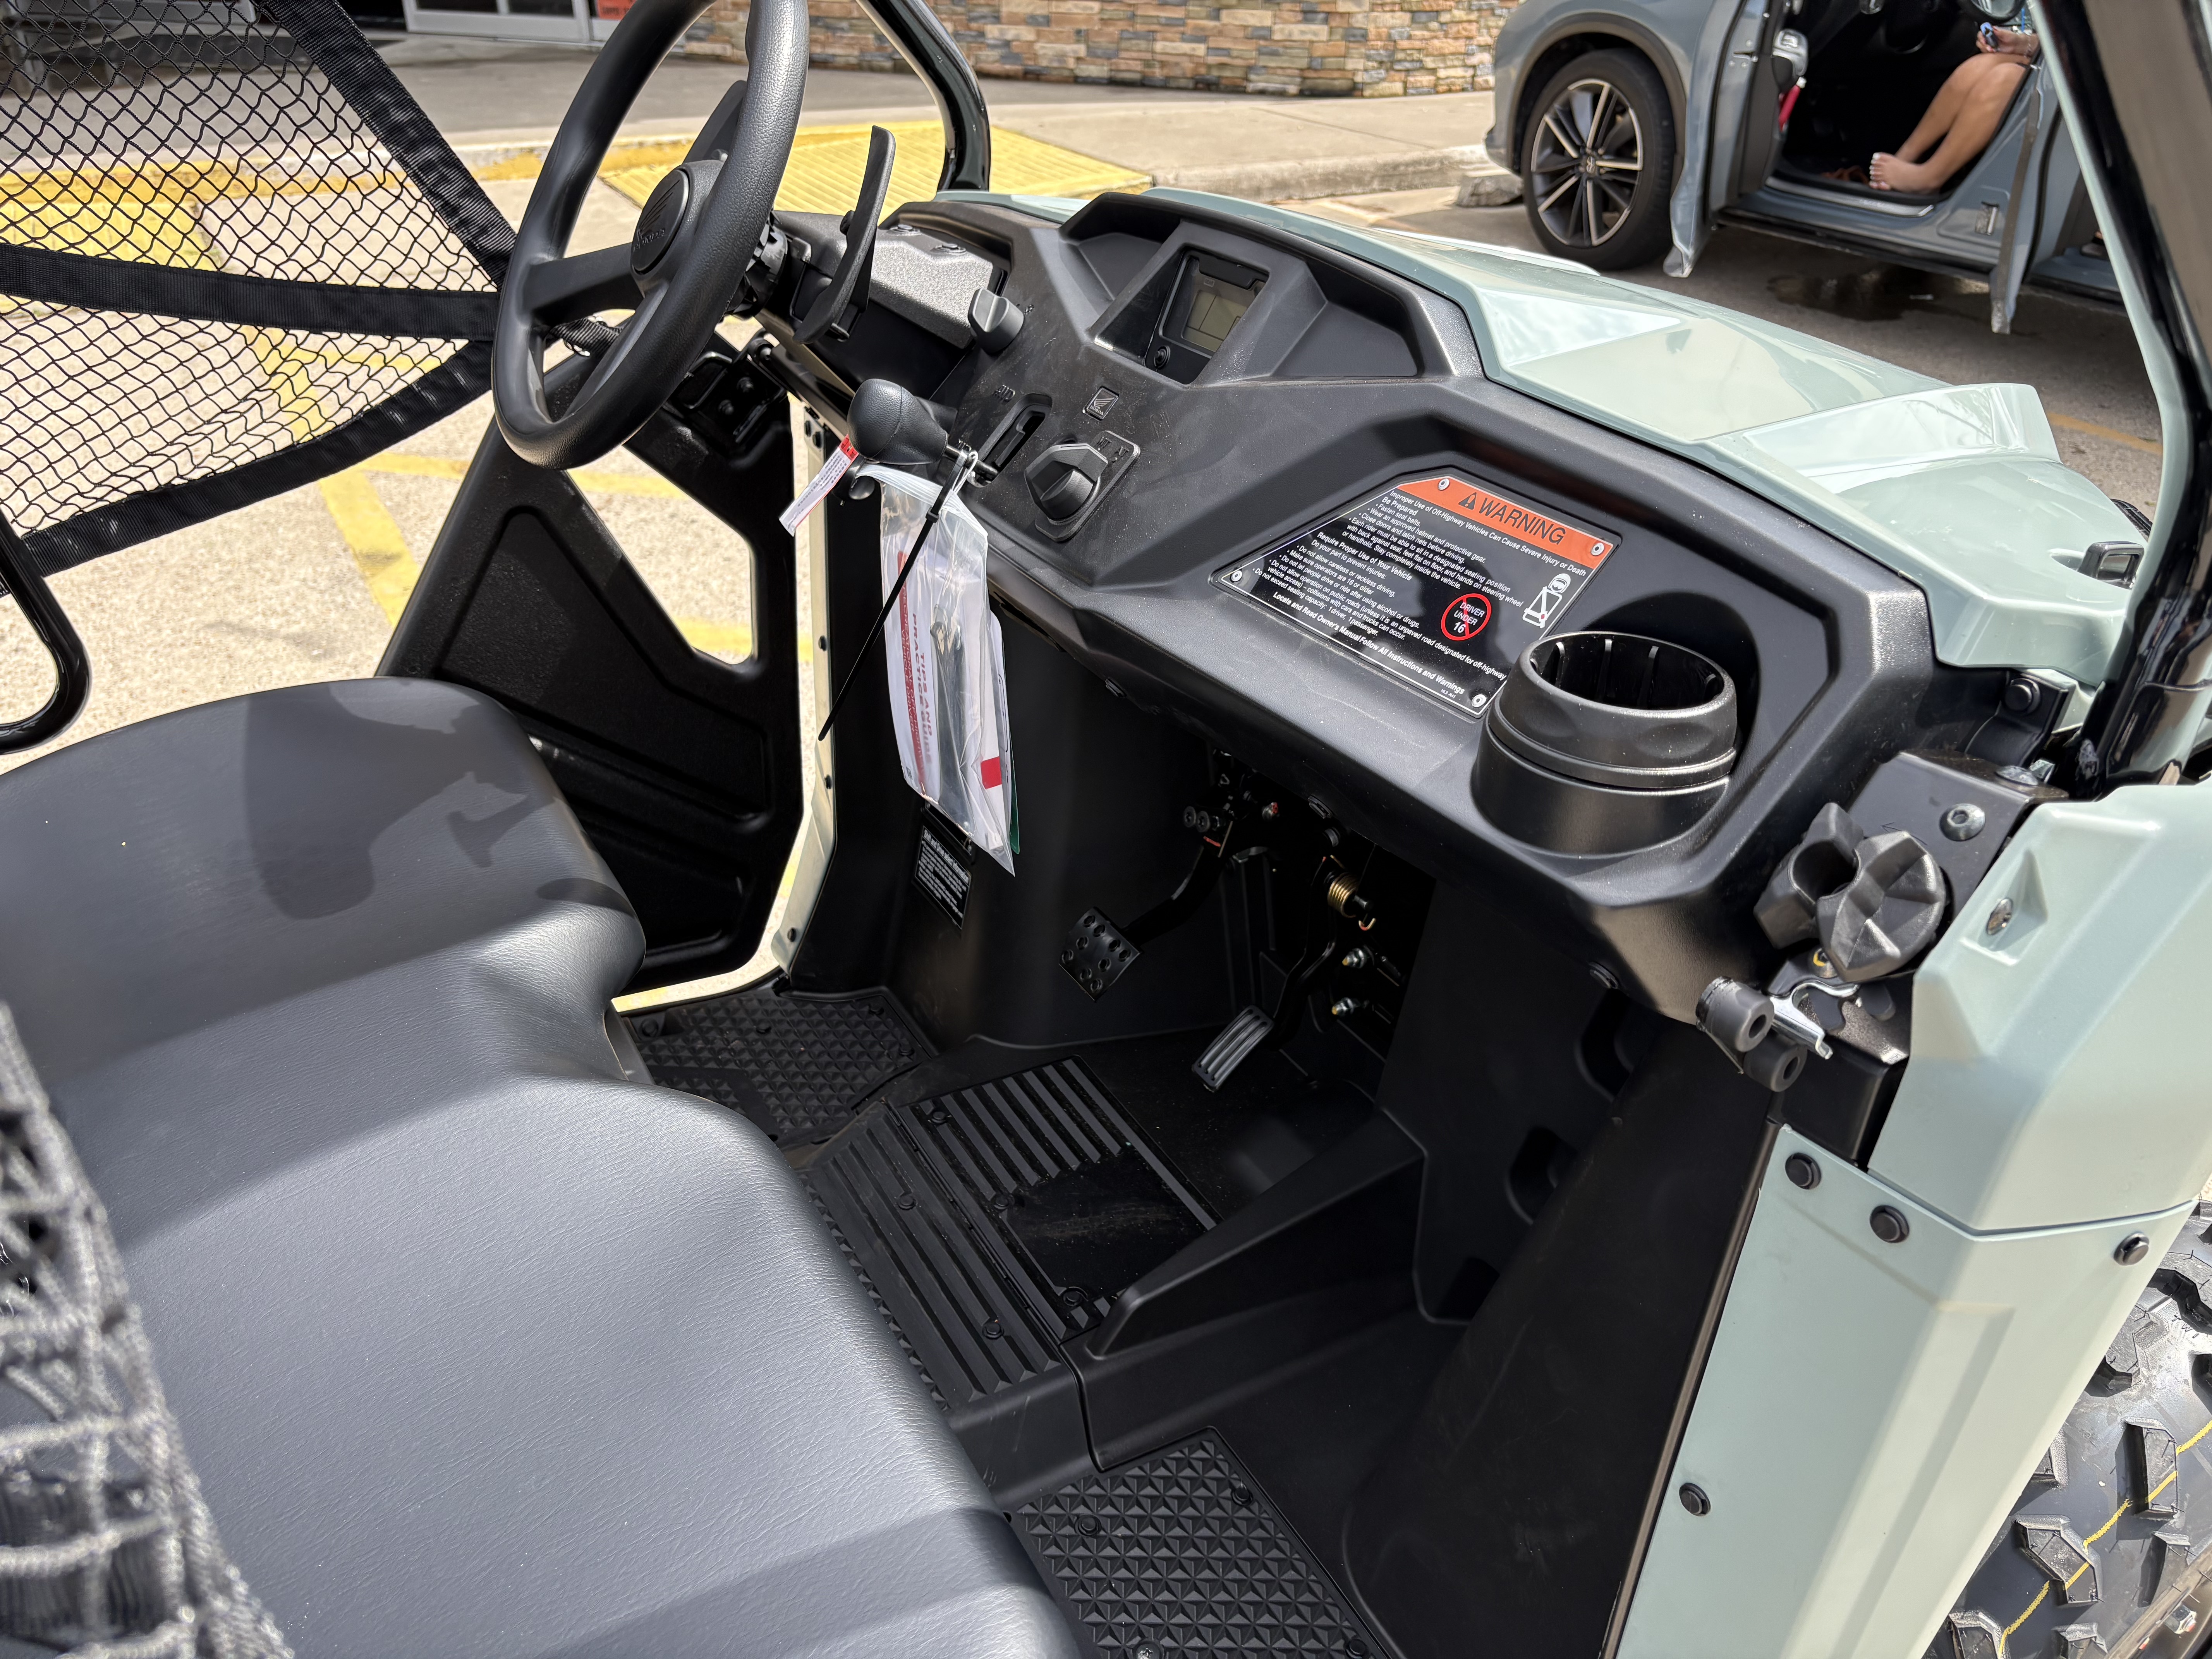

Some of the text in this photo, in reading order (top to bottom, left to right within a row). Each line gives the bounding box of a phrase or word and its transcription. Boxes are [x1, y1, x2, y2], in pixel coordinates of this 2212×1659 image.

[1377, 503, 1420, 527] Fasten seat belts.
[1382, 496, 1419, 516] Be Prepared
[1479, 498, 1566, 544] WARNING
[1317, 531, 1339, 546] Require
[1338, 542, 1359, 555] Proper
[1358, 551, 1370, 561] Use
[1377, 560, 1391, 570] Your
[1391, 566, 1412, 581] Vehicle
[1351, 517, 1365, 527] Each
[1364, 524, 1377, 532] rider
[1376, 530, 1391, 539] must
[1397, 539, 1410, 548] able
[1433, 555, 1466, 572] designated
[1464, 569, 1486, 583] seating
[1485, 579, 1511, 593] position
[1361, 513, 1465, 564] Close doors and latch nets before driving.
[1370, 508, 1384, 518] Wear
[1390, 518, 1417, 532] approved
[1415, 528, 1435, 540] helmet
[1443, 542, 1472, 557] protective
[1470, 554, 1486, 563] gear.
[1389, 490, 1415, 505] Improper
[1414, 500, 1425, 509] Use
[1432, 508, 1465, 527] Off-Highway
[1465, 522, 1489, 536] Vehicles
[1489, 532, 1501, 541] Can
[1501, 537, 1520, 550] Cause
[1520, 545, 1542, 558] Severe
[1541, 554, 1560, 567] Injury
[1567, 564, 1586, 576] Death
[1289, 550, 1303, 560] Make
[1302, 557, 1314, 566] sure
[1314, 563, 1338, 577] operators
[1359, 586, 1374, 595] older
[1311, 539, 1320, 547] Do
[1318, 544, 1332, 553] your
[1329, 550, 1343, 558] part
[1345, 557, 1367, 570] prevent
[1365, 565, 1387, 580] injuries:
[1315, 555, 1329, 563] allow
[1328, 561, 1349, 574] careless
[1355, 574, 1377, 587] reckless
[1376, 584, 1395, 598] driving.
[1347, 524, 1358, 533] with
[1357, 529, 1371, 539] back
[1370, 536, 1391, 548] against
[1389, 544, 1402, 554] seat,
[1402, 549, 1415, 559] feet
[1413, 554, 1424, 563] flat
[1430, 562, 1444, 574] floor,
[1444, 569, 1457, 578] and
[1455, 573, 1474, 586] hands
[1481, 586, 1505, 601] steering
[1505, 596, 1524, 607] wheel
[1348, 532, 1373, 549] handhold.
[1374, 544, 1387, 555] Stay
[1386, 551, 1415, 568] completely
[1414, 563, 1431, 575] inside
[1431, 571, 1441, 580] the
[1440, 576, 1461, 589] vehicle.
[1303, 568, 1321, 579] people
[1321, 576, 1334, 585] drive
[1339, 585, 1350, 593] ride
[1350, 591, 1363, 599] after
[1362, 596, 1377, 608] using
[1376, 604, 1398, 617] alcohol
[1403, 617, 1419, 629] drugs.
[1454, 610, 1478, 626] UNDER
[1460, 601, 1485, 618] DRIVER
[1273, 591, 1465, 694] Locate and Read Owner's Manual Follow All Instructions and Warnings
[1286, 568, 1301, 578] allow
[1300, 575, 1323, 590] operation
[1329, 591, 1346, 601] public
[1345, 598, 1361, 609] roads
[1360, 605, 1380, 618] (unless
[1398, 625, 1423, 639] unpaved
[1421, 636, 1436, 646] road
[1434, 642, 1467, 661] designated
[1464, 656, 1475, 665] for
[1473, 661, 1507, 681] off-highway
[1453, 622, 1467, 633] 16
[913, 613, 924, 706] PRACTICE
[906, 686, 914, 732] DRIVER
